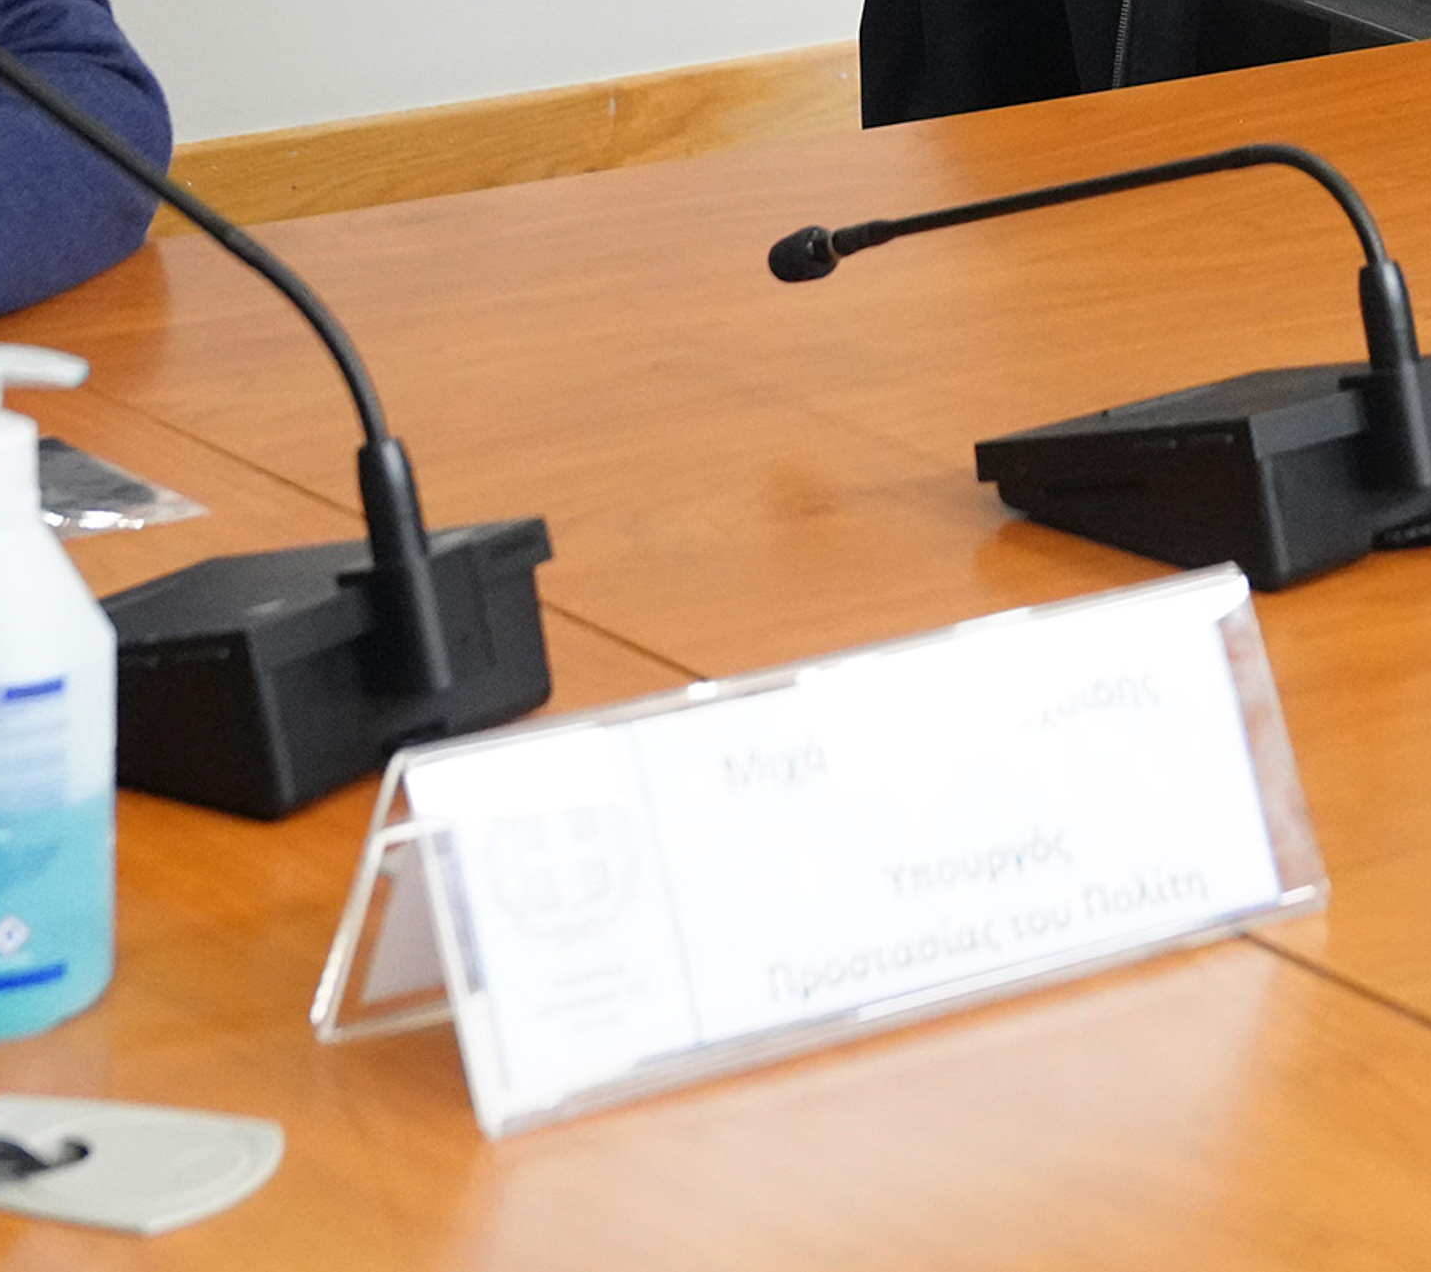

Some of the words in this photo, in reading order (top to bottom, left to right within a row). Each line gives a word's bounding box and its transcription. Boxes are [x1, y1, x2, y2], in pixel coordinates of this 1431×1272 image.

[722, 731, 828, 794] Μιχά
[882, 827, 1074, 901] Υπουργός
[765, 917, 1002, 1002] Προστασίας
[1011, 903, 1072, 940] του
[1082, 865, 1211, 925] Πολίτη
